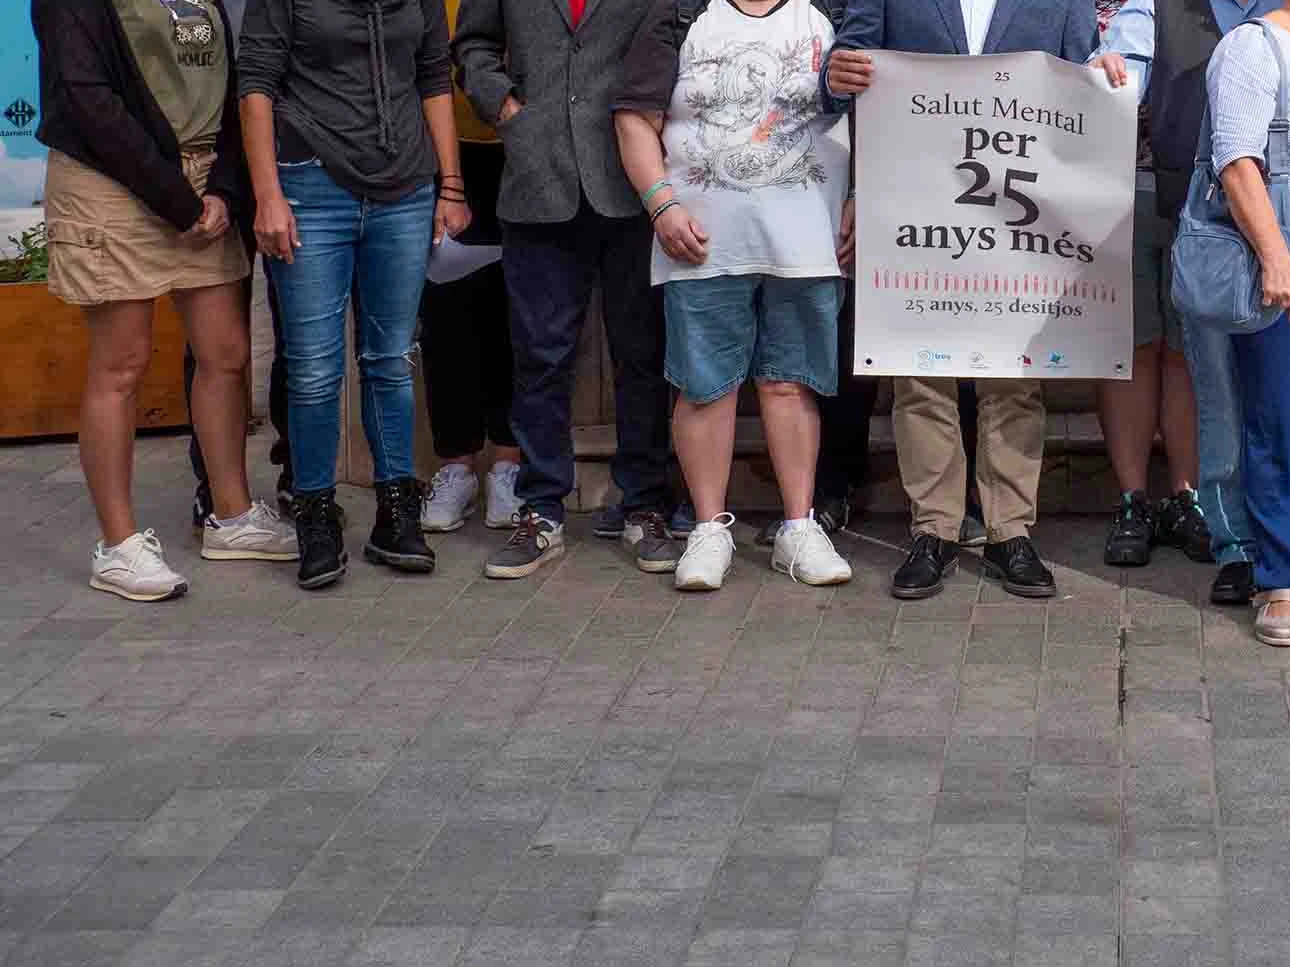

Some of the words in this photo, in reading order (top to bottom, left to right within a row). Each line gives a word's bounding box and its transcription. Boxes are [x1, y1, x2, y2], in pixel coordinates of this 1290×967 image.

[994, 71, 1010, 83] 25
[911, 93, 982, 117] Salut
[991, 96, 1085, 136] Mental
[962, 127, 1037, 159] per
[954, 161, 1040, 227] 25
[895, 223, 996, 260] anys
[1010, 226, 1094, 264] més
[905, 299, 925, 315] 25
[929, 298, 978, 316] anys,
[984, 300, 1003, 316] 25
[1008, 298, 1083, 319] desitjos
